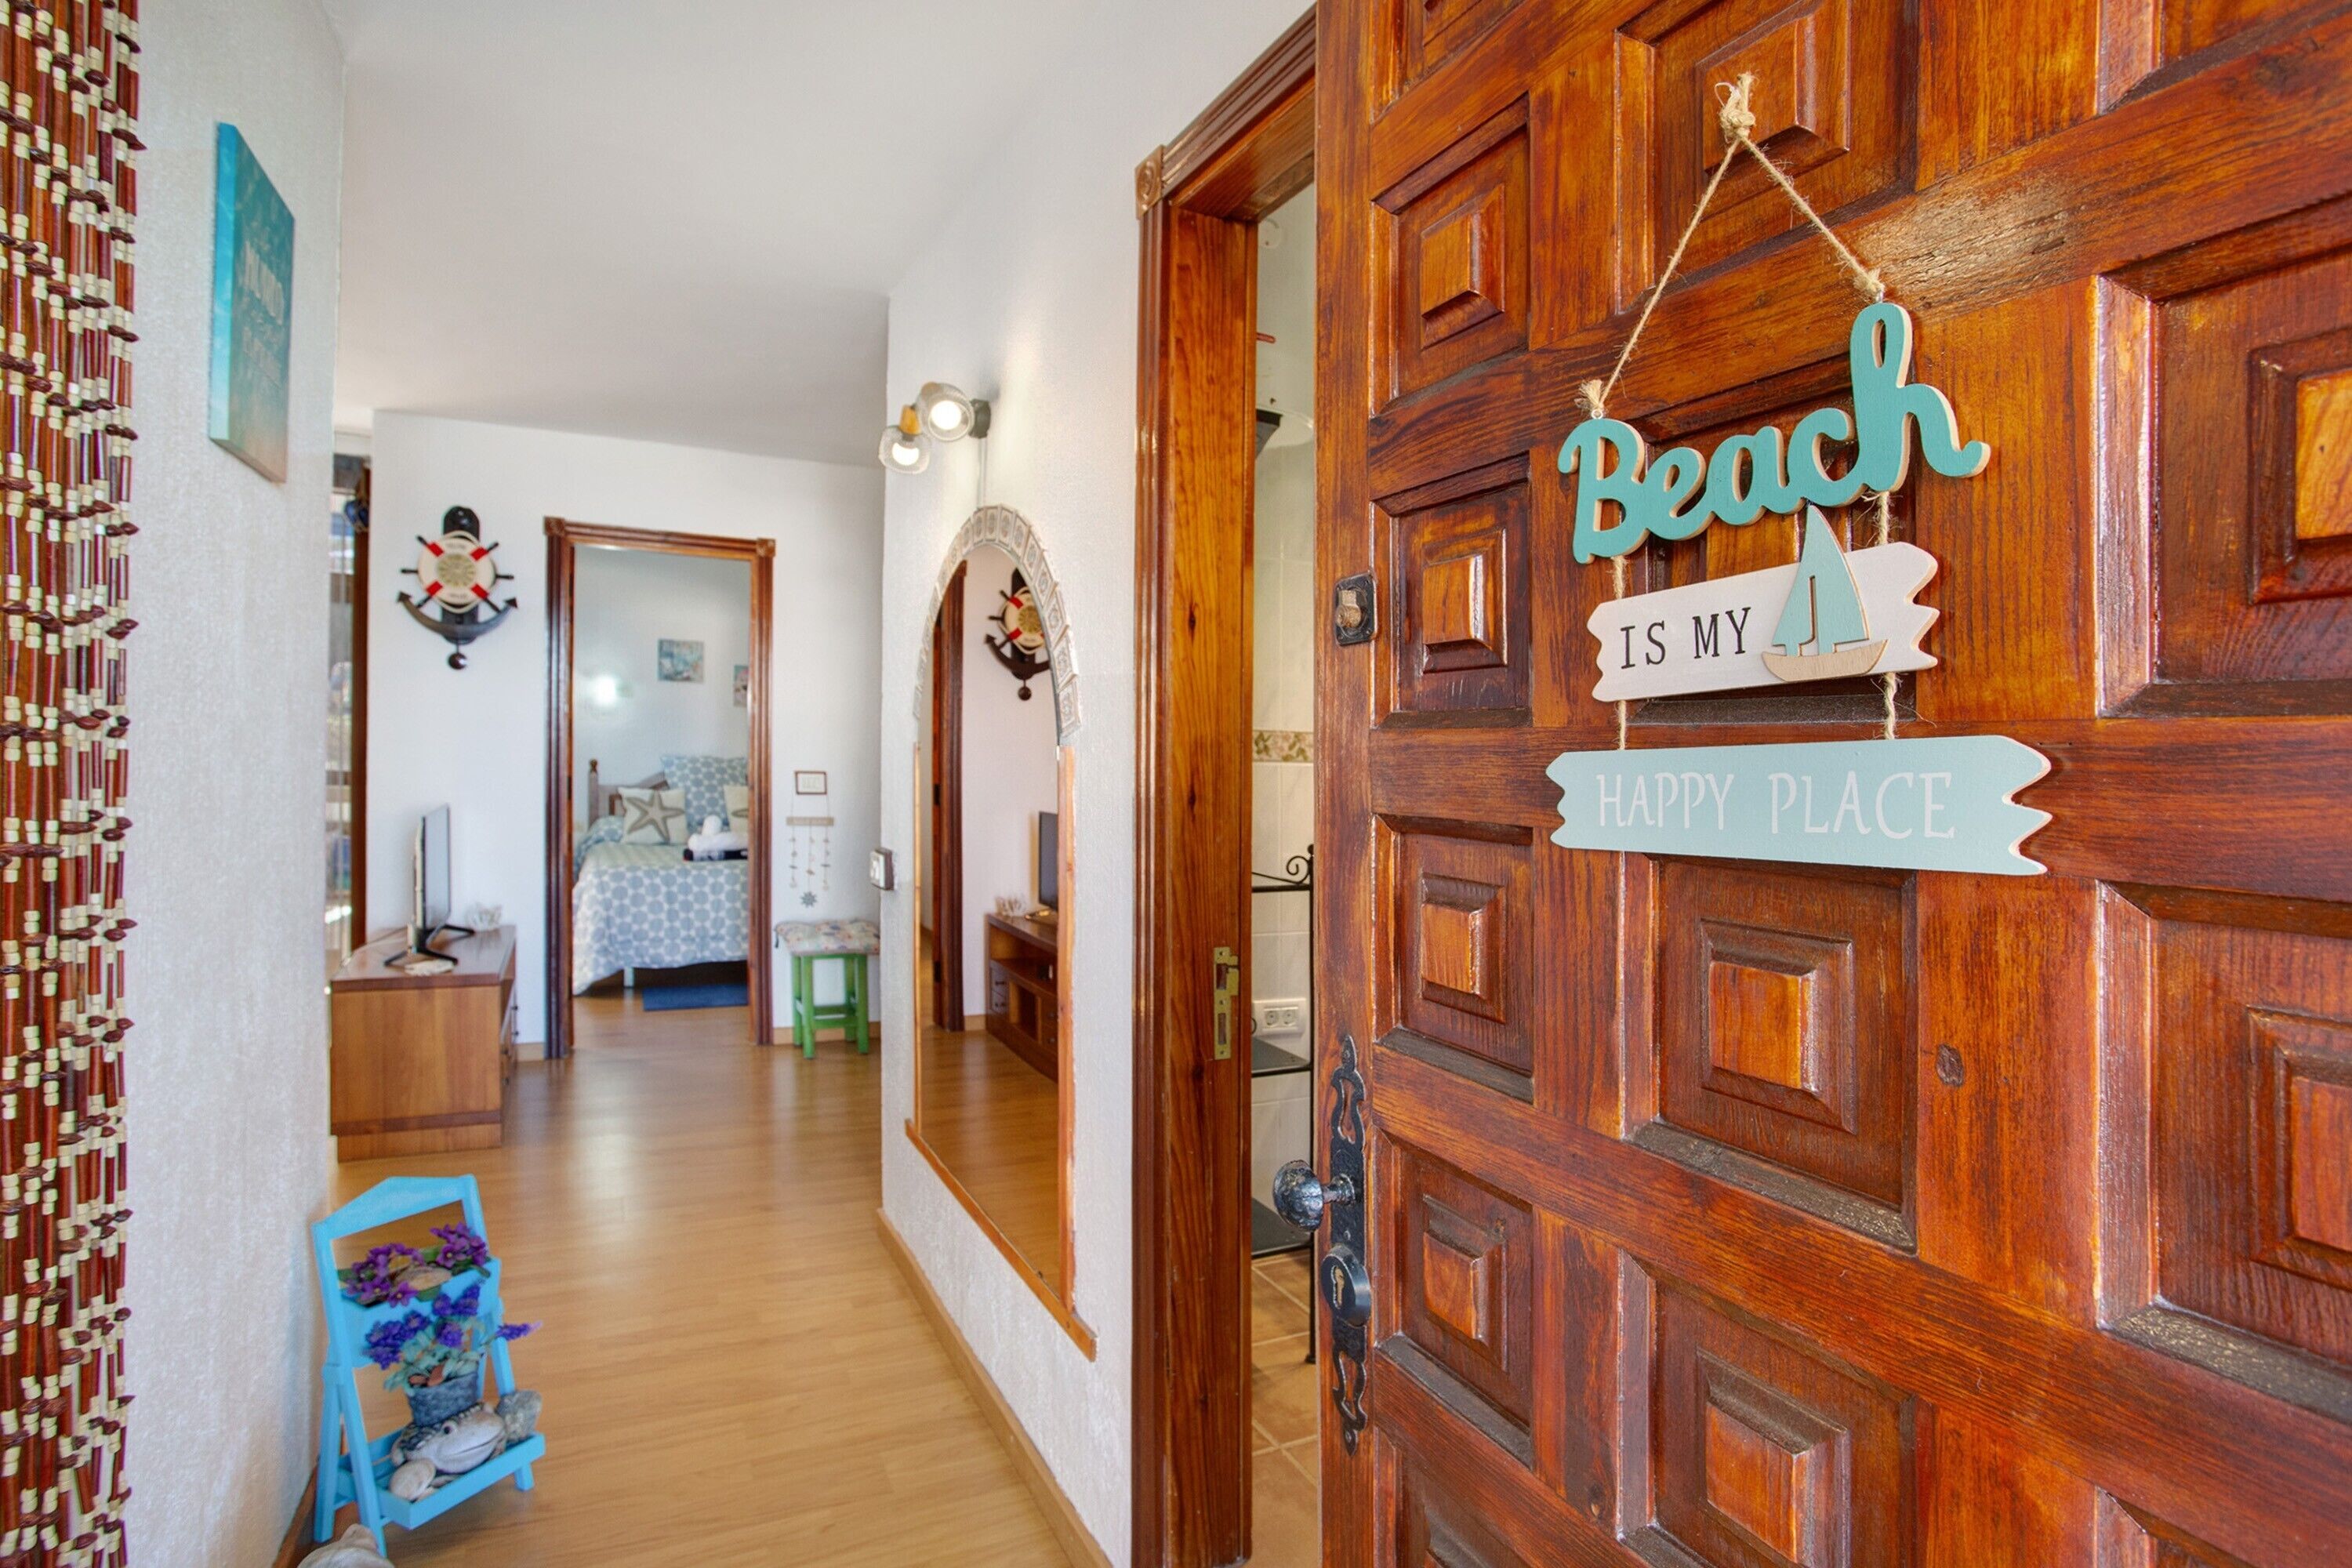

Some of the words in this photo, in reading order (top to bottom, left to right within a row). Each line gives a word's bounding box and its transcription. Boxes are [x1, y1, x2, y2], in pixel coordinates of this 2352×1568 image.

[1557, 302, 1991, 564] Beach
[1620, 621, 1667, 670] IS
[1693, 606, 1752, 659] MY
[1595, 771, 1735, 830] HAPPY
[1769, 771, 1955, 840] PLACE
